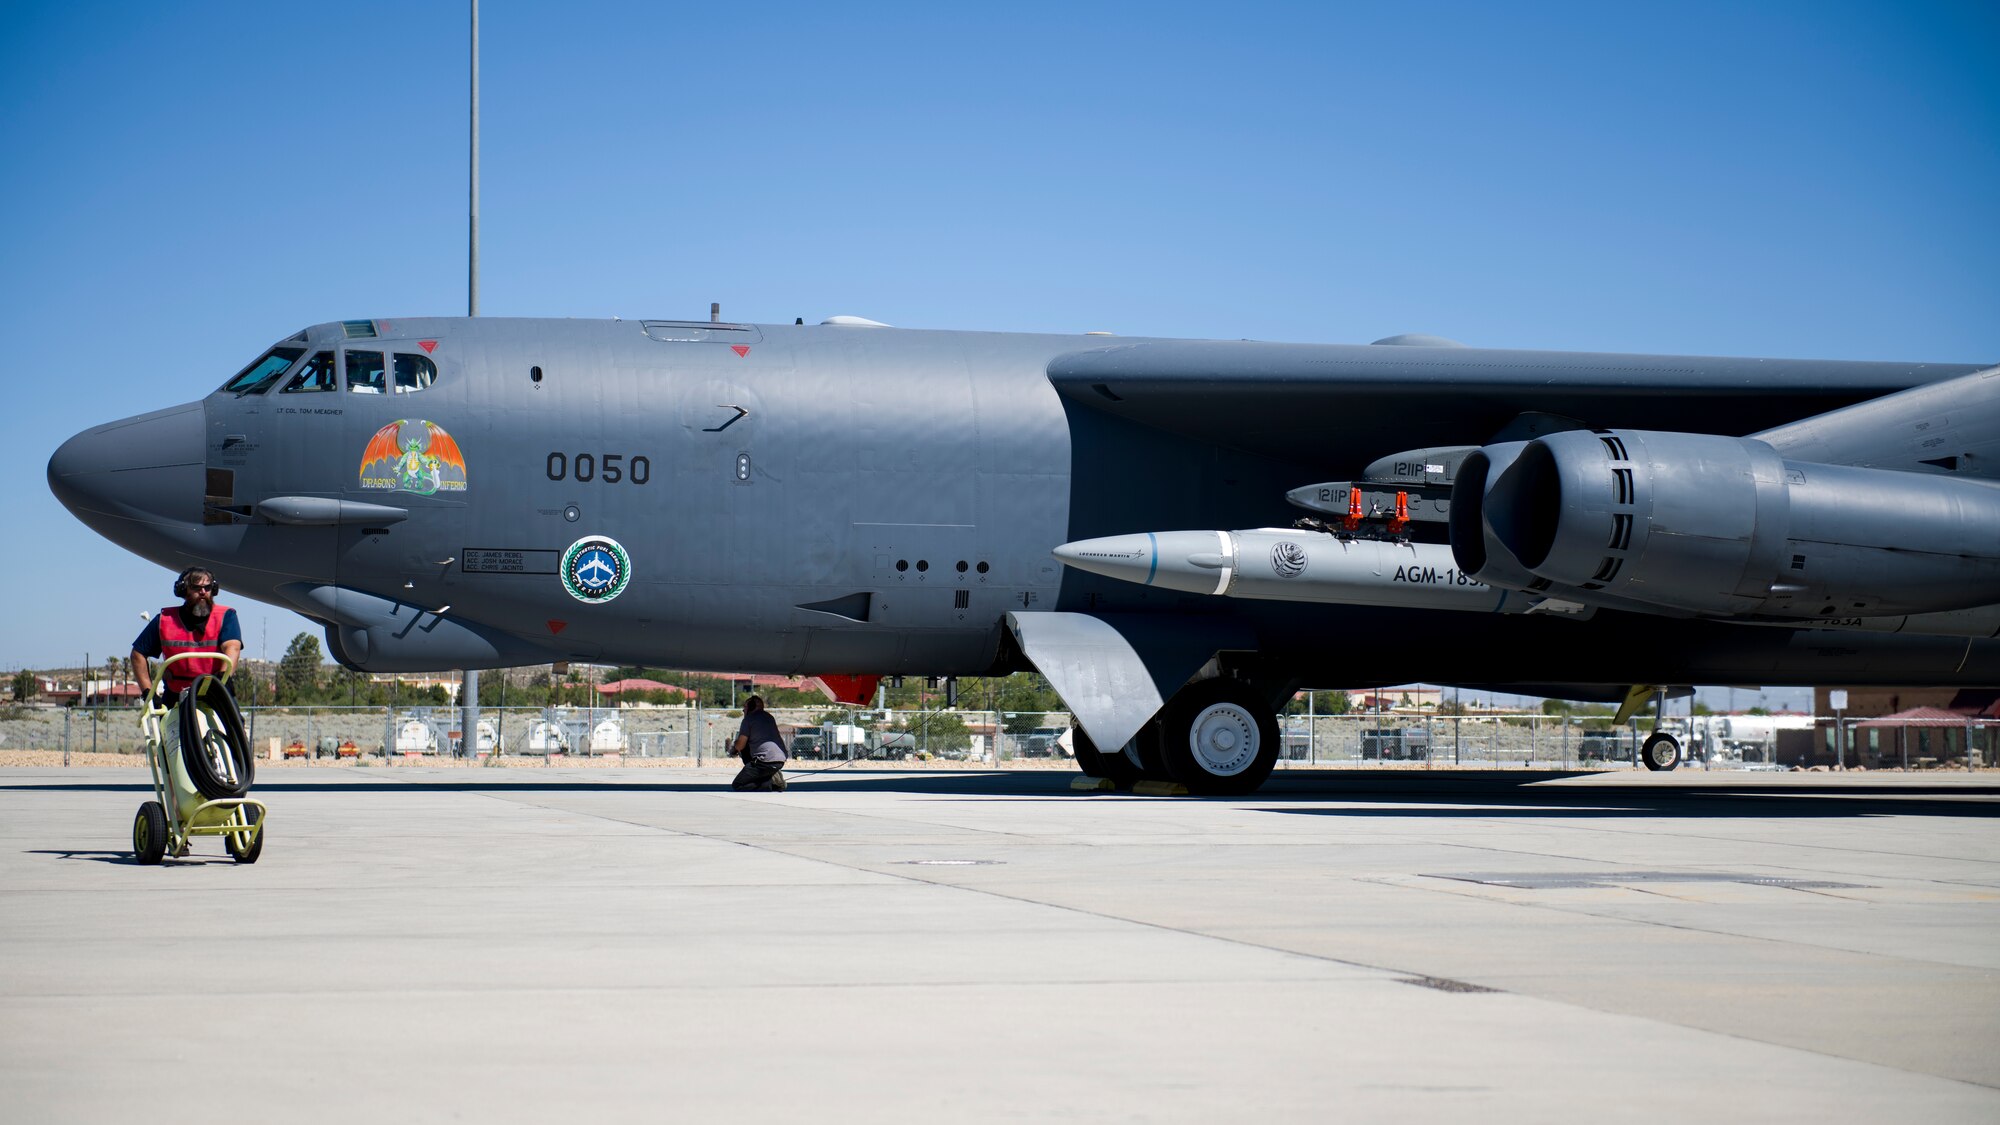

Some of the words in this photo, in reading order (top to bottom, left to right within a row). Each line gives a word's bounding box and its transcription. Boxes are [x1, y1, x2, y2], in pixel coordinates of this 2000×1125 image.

[314, 408, 343, 416] MEAGHER
[547, 452, 650, 485] 0050
[1394, 462, 1425, 477] 1211P
[440, 481, 467, 491] INFERNO
[1319, 488, 1348, 503] 1211P
[573, 545, 596, 563] SYNTHETIC
[608, 551, 620, 565] BLEND
[1393, 565, 1483, 587] AGM-18
[572, 578, 618, 594] CERTIFIED
